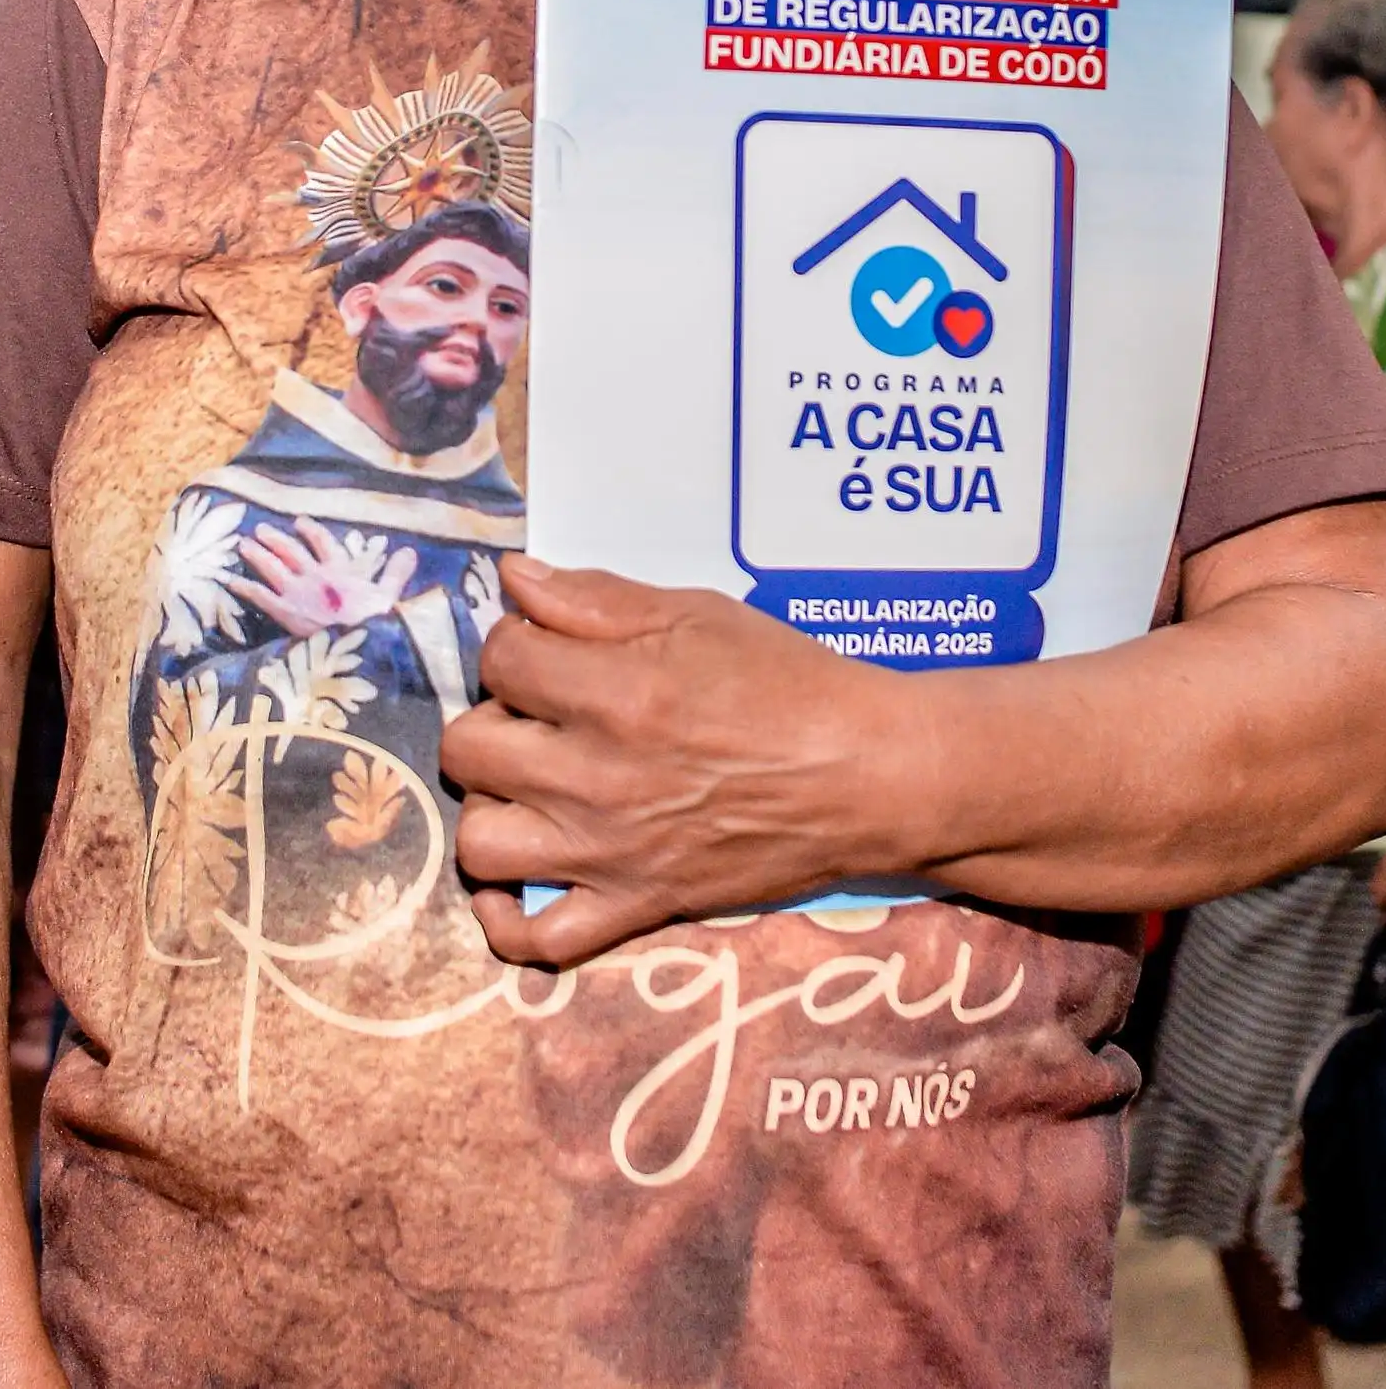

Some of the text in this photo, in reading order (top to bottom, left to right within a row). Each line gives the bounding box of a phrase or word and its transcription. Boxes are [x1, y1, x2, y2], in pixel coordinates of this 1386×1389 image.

[708, 31, 1103, 86] FUNDIÁRIA DE CODÓ
[789, 371, 1005, 395] PROGRAMA
[790, 401, 1005, 453] A CASA
[839, 456, 1002, 513] é SUA
[788, 594, 997, 627] REGULARIZAÇÃO
[806, 627, 994, 656] NDIÁRIA 2025
[765, 1061, 977, 1134] POR NÓS
